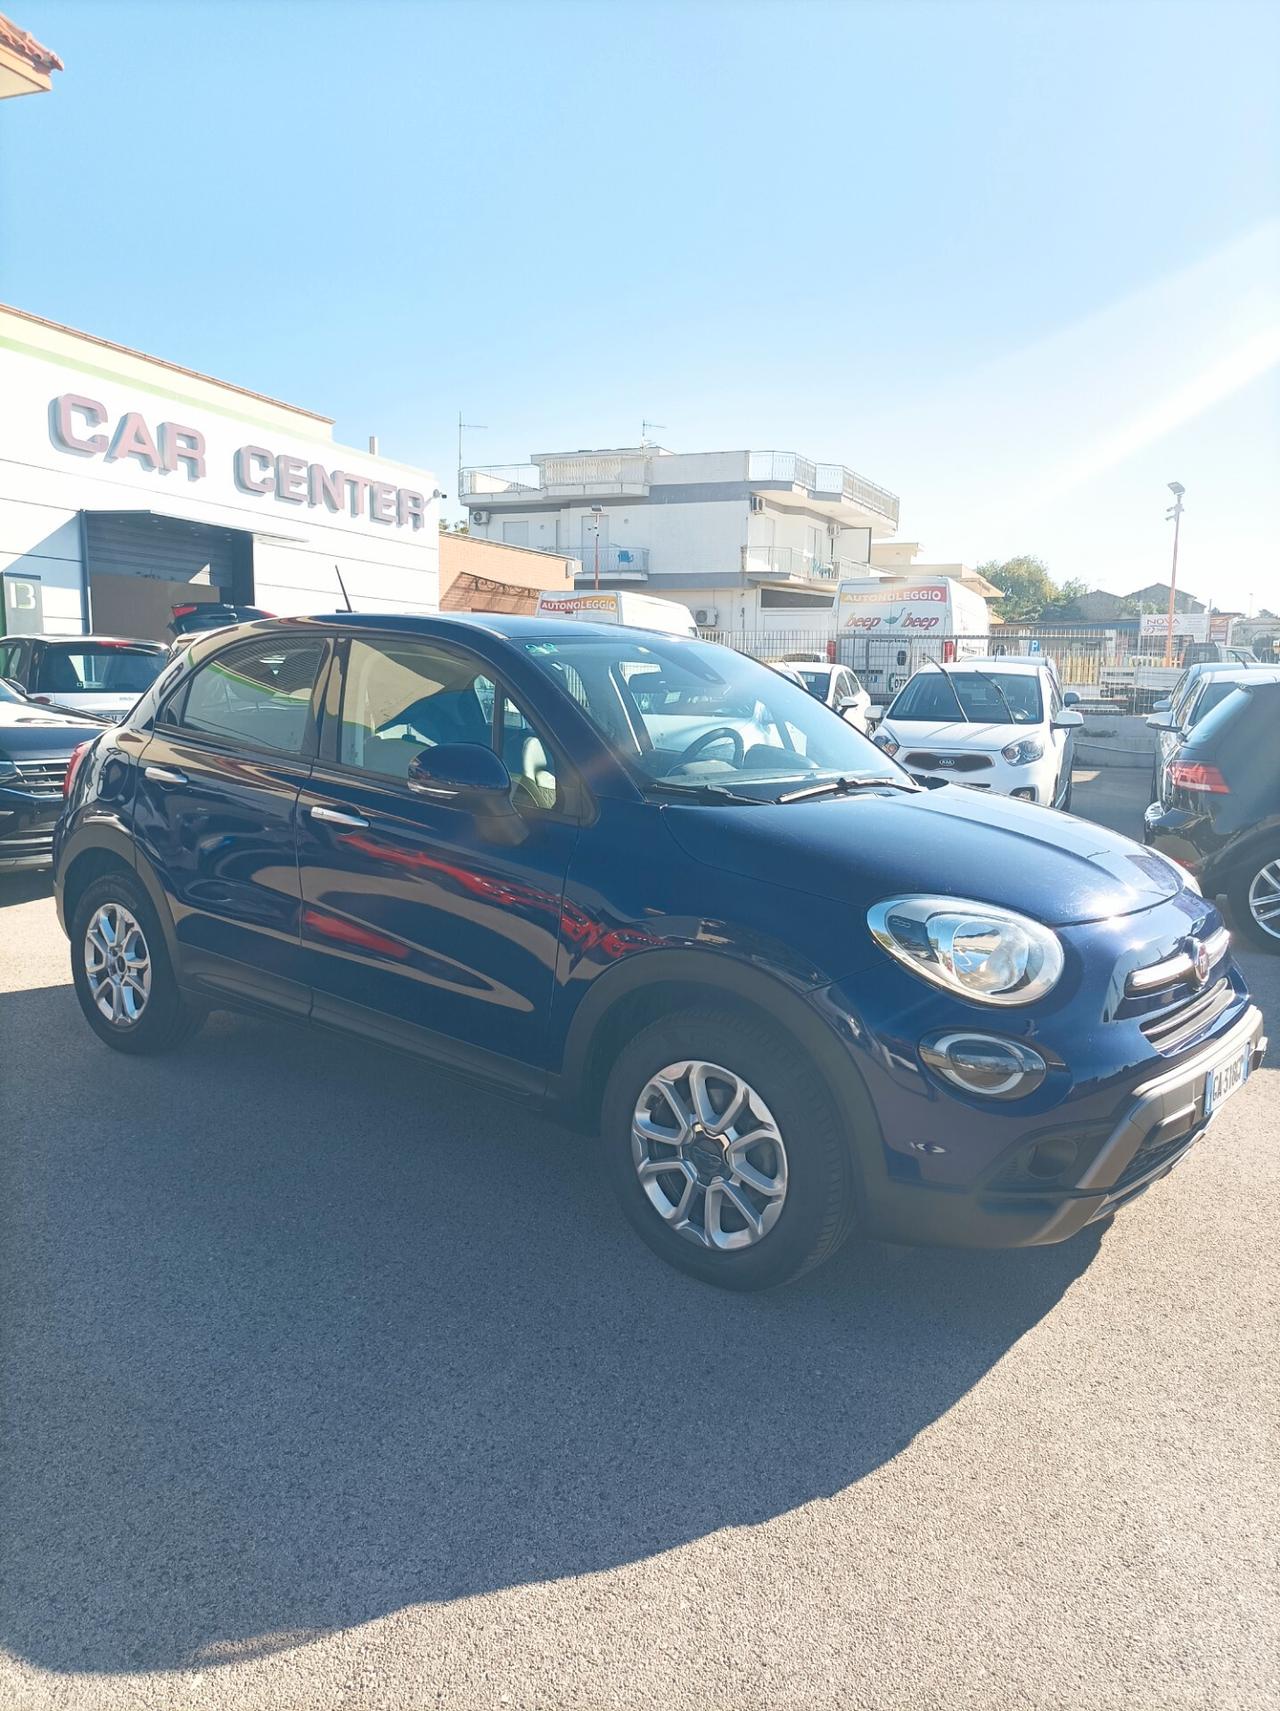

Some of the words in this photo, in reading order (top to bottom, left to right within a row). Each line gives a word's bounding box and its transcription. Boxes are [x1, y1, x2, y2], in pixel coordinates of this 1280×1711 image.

[48, 393, 207, 482] CAR
[233, 445, 426, 531] CENTER
[846, 590, 941, 602] AUTONOLEGGIO
[541, 600, 616, 610] AUTONOLEGGIO
[845, 612, 881, 630] beep
[901, 612, 939, 630] beep
